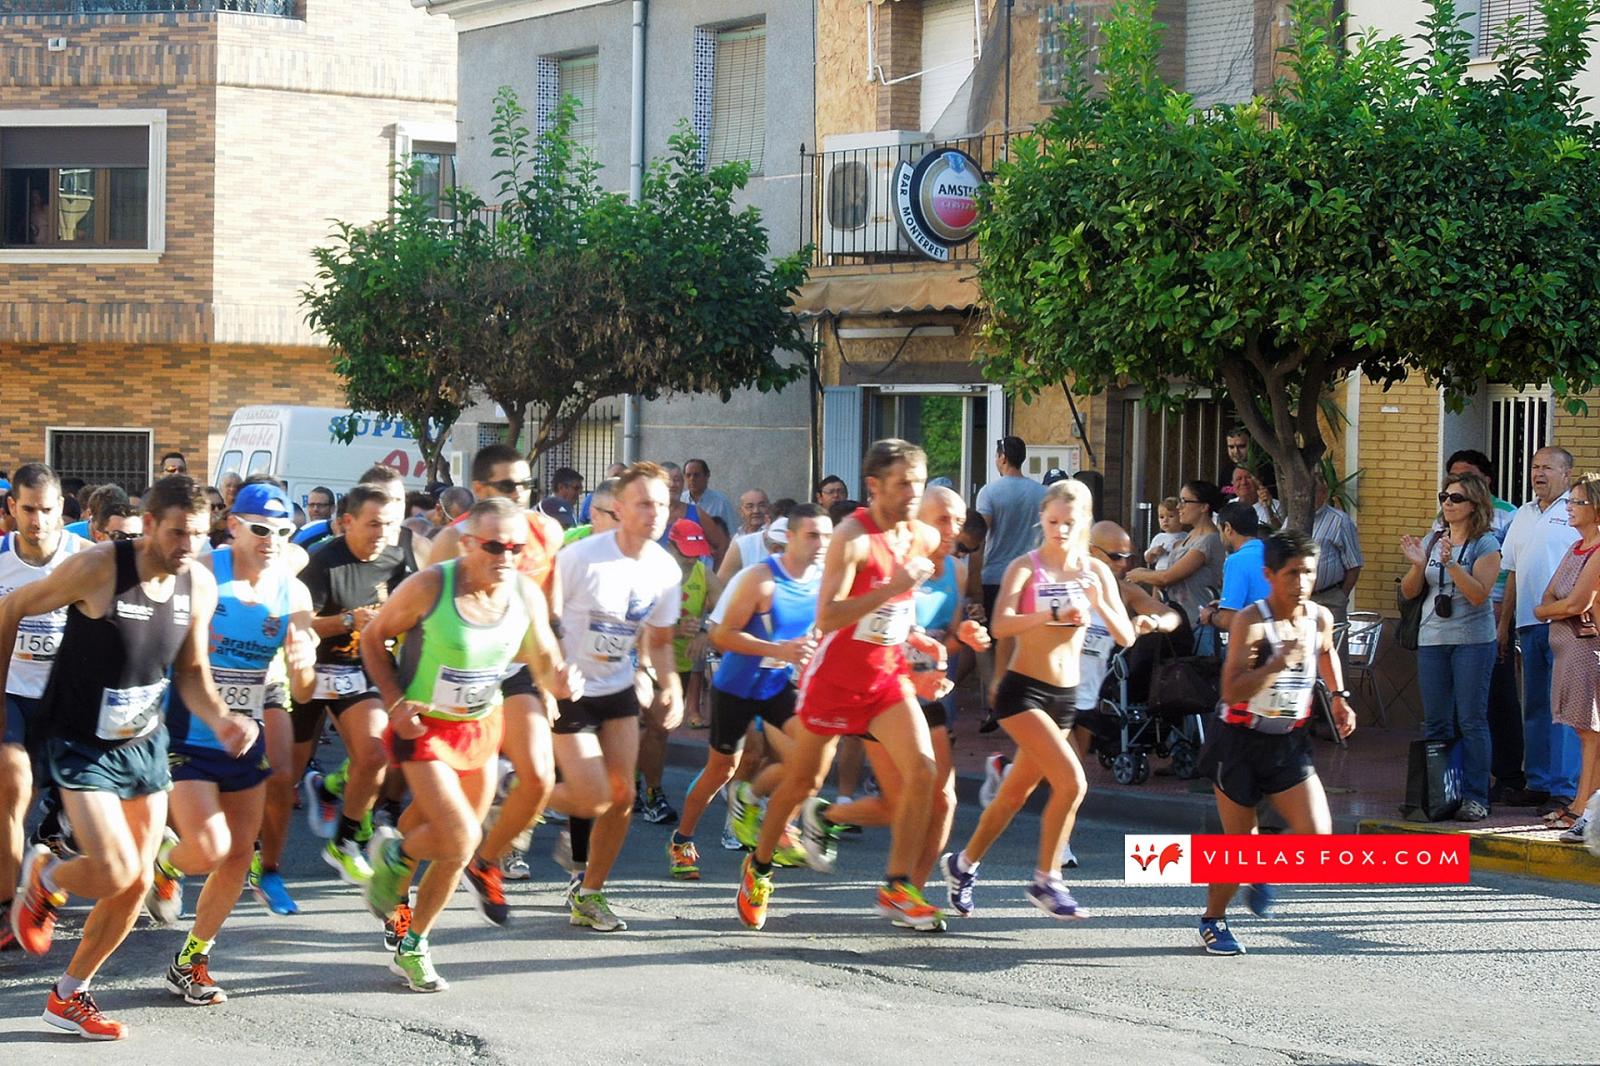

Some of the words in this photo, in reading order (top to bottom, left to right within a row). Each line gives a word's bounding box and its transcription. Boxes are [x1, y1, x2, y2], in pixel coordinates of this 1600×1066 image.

[900, 173, 911, 196] BAR
[902, 206, 946, 258] MONTERREY
[18, 634, 56, 653] 156
